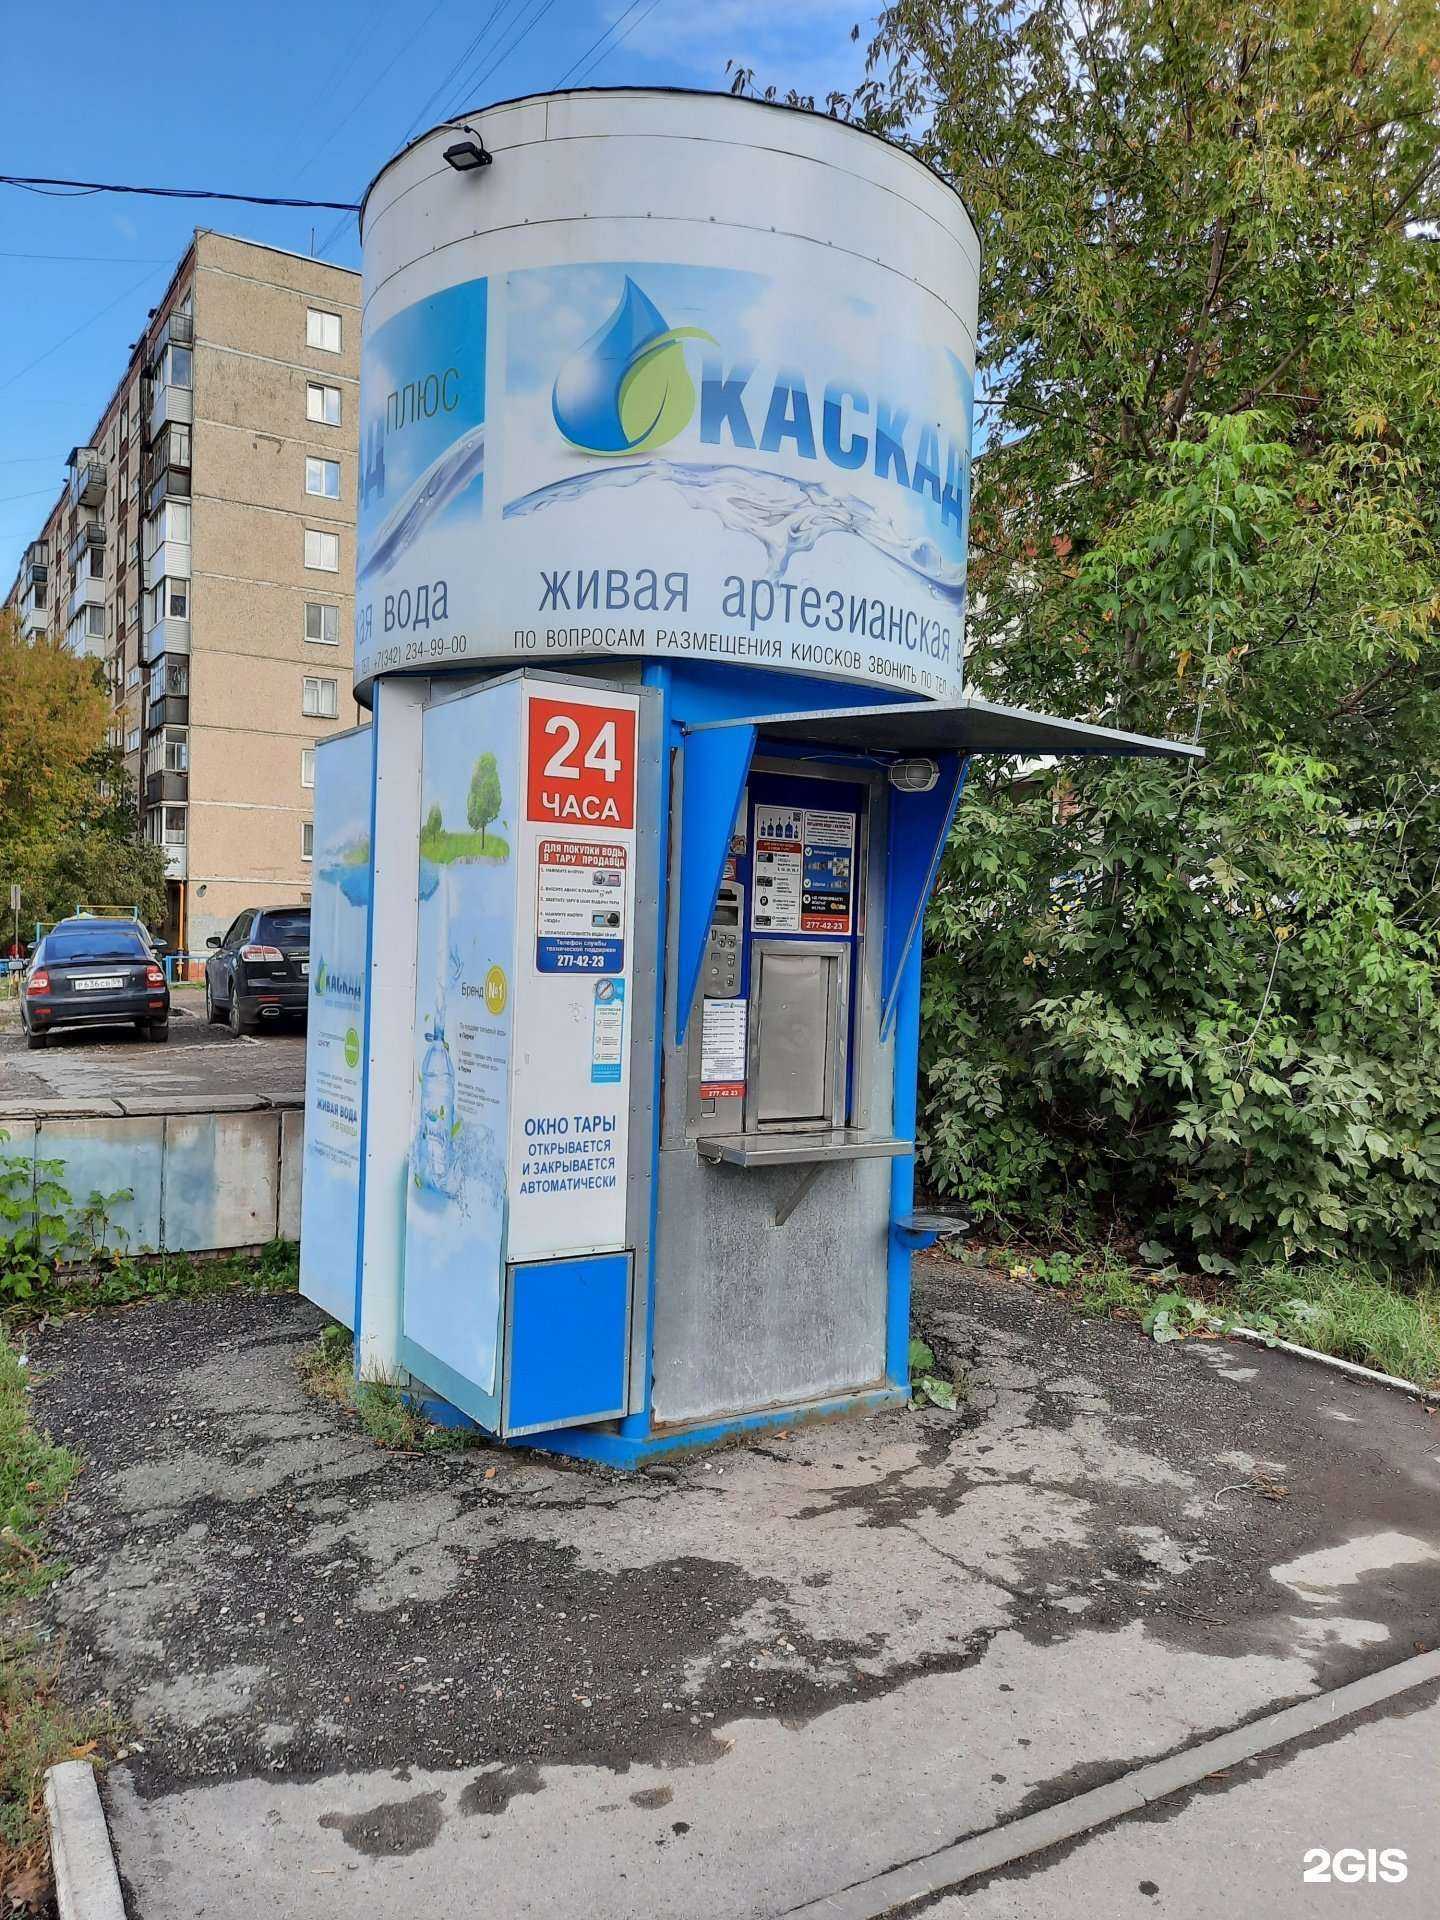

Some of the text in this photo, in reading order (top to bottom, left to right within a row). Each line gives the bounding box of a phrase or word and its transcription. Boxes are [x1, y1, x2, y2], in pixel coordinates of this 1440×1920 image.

[387, 368, 459, 435] ПЛЮС
[700, 356, 963, 538] КАСКАД
[405, 634, 467, 661] 234-99-00
[514, 630, 536, 648] ПО
[546, 628, 645, 648] ВОПРОСАМ
[656, 629, 782, 658] РАЗМЕЩЕНИЯ
[792, 642, 861, 669] КИОСКОВ
[868, 655, 917, 684] ЗВОНИТЬ
[920, 670, 932, 689] ПО
[543, 715, 622, 782] 24
[542, 791, 620, 822] ЧАСА
[543, 843, 625, 857] ДЛЯ ПОКУПКИ ВОДЫ
[543, 853, 625, 867] В ТАРУ ПРОДАВЦА
[805, 921, 843, 930] 277-42-23
[557, 954, 605, 967] 277-42-23
[524, 1115, 616, 1136] ОКНО ТАРЫ
[528, 1139, 611, 1157] ОТКРЫВАЕТСЯ
[522, 1157, 615, 1176] И ЗАКРЫВАЕТСЯ
[520, 1175, 616, 1195] АВТОМАТИЧЕСКИ
